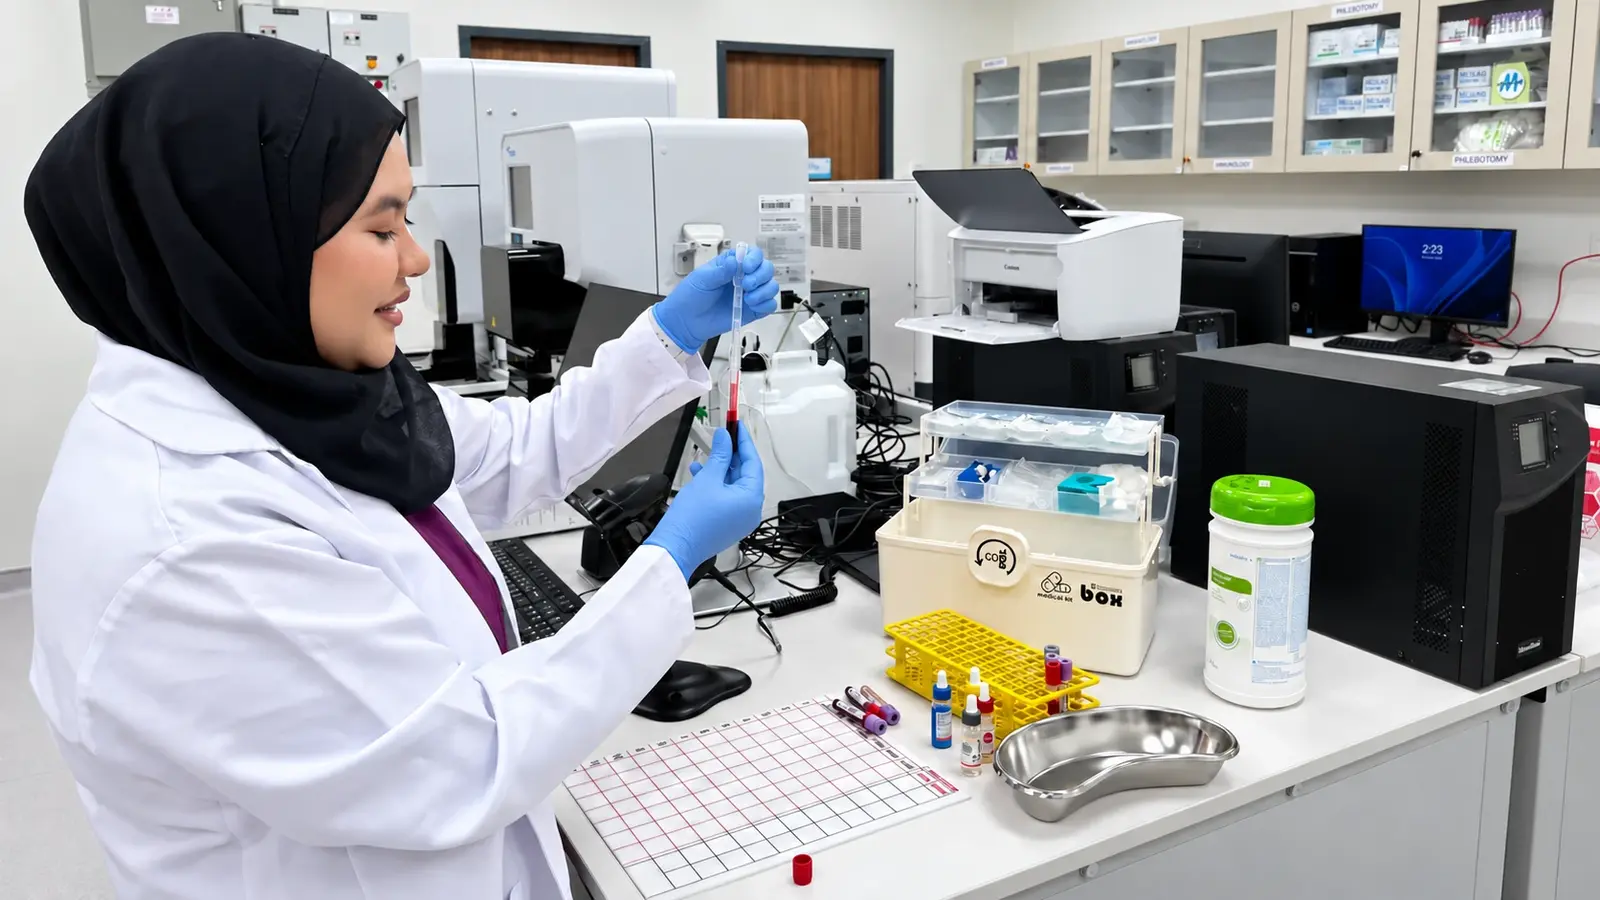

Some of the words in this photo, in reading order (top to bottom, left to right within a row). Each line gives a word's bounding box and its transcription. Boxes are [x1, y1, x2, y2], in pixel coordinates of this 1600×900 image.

[1454, 155, 1509, 164] PHLEBOTOMY
[1422, 244, 1443, 255] 2:23
[1037, 593, 1063, 601] medical
[1080, 584, 1122, 607] box
